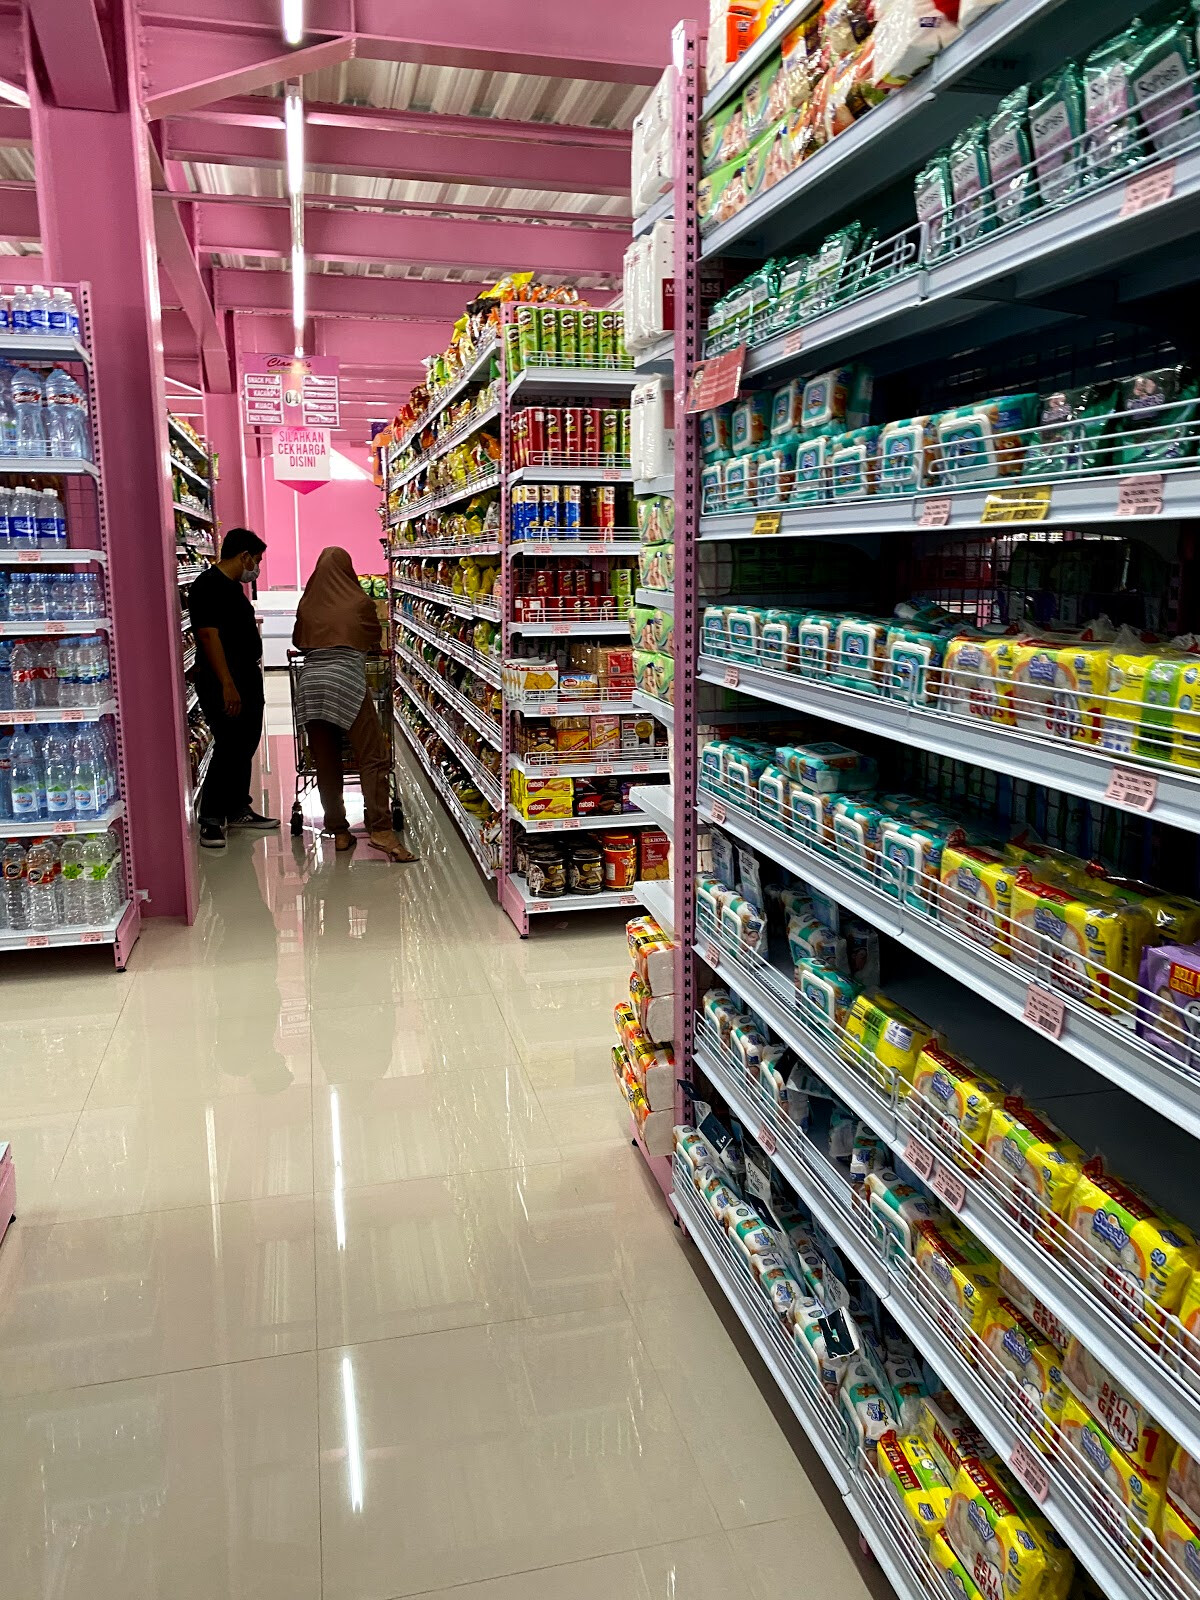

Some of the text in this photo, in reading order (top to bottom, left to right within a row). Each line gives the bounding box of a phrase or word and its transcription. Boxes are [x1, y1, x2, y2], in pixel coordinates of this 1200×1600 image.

[285, 391, 299, 404] 04
[279, 430, 324, 443] SILAHKAN
[278, 443, 326, 455] CEK HARGA
[289, 456, 316, 467] DISINI
[1093, 1209, 1129, 1250] Sweety
[1151, 1248, 1167, 1266] 50
[1106, 1265, 1137, 1299] BELI
[1003, 1328, 1032, 1366] Sweety
[1098, 1397, 1139, 1452] GRATIS
[1101, 1381, 1160, 1463] BELI 1
[898, 1470, 915, 1490] BELI
[1129, 1474, 1143, 1494] 50
[988, 1496, 1010, 1518] BELI
[968, 1499, 995, 1542] Sweety
[976, 1552, 998, 1590] BELI
